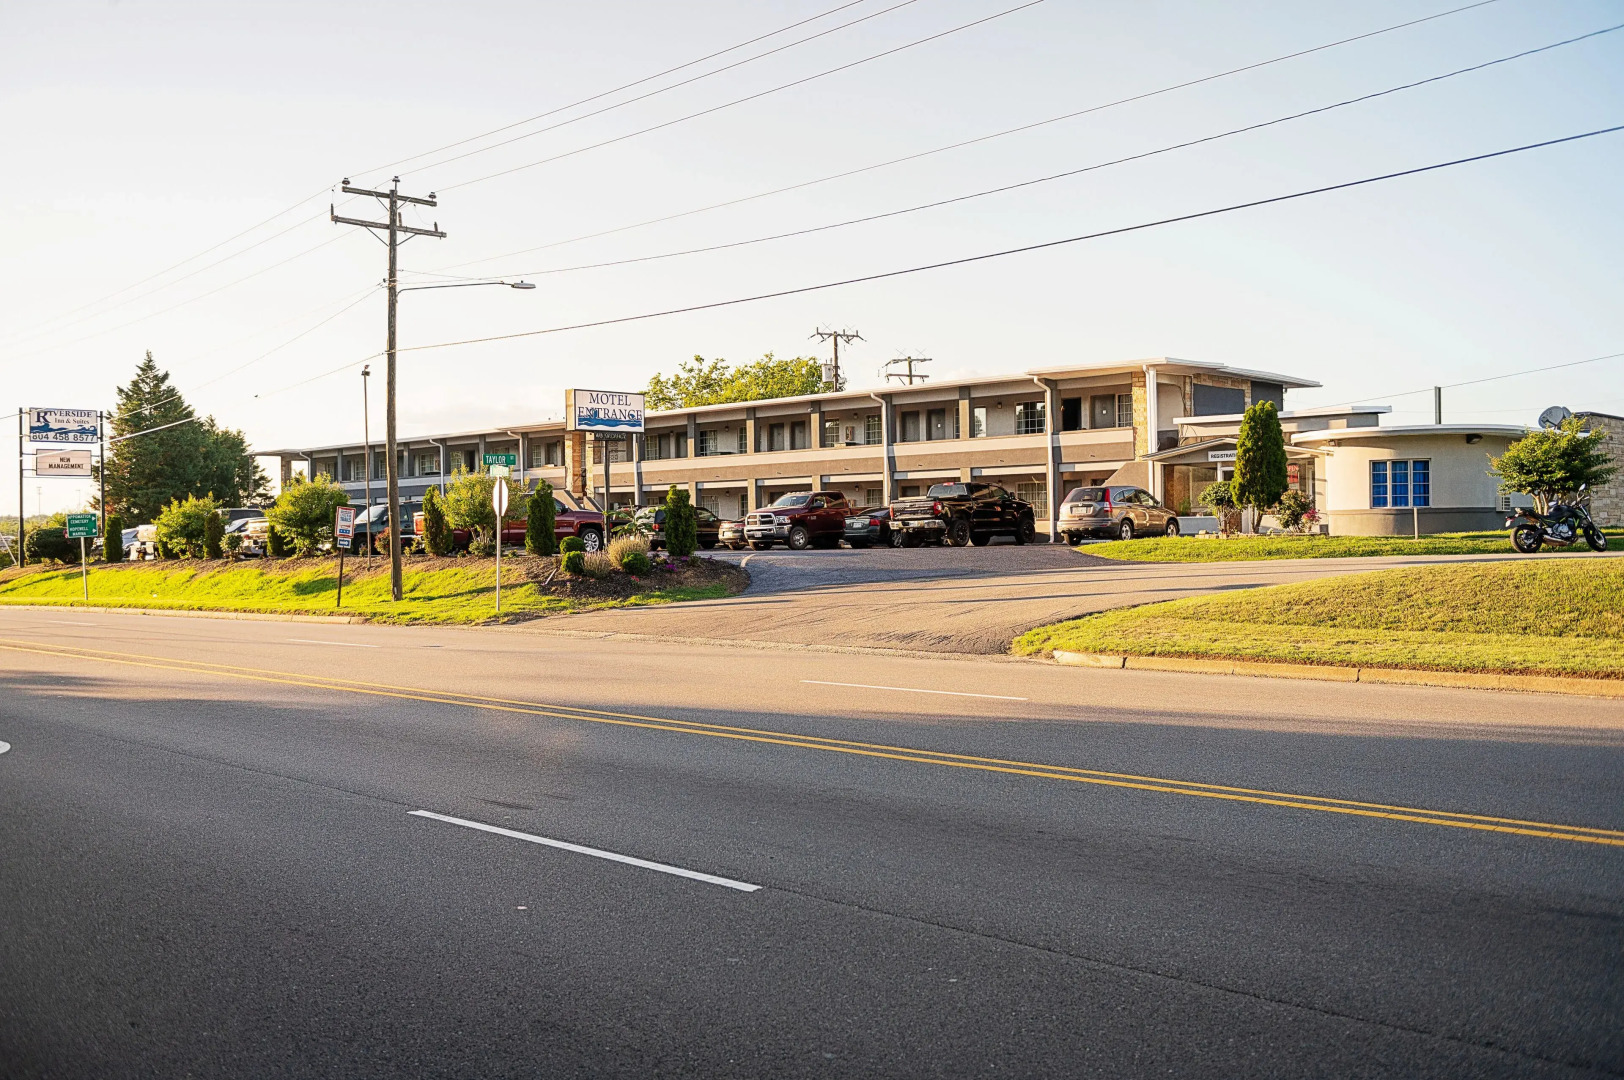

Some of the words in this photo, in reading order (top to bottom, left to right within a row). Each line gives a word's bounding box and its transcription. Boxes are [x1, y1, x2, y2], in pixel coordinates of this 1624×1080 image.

[589, 393, 631, 406] MOTEL
[35, 410, 92, 423] RIVERSIDE
[578, 406, 642, 420] ENTRANCE
[53, 433, 69, 441] 458
[486, 455, 506, 464] TAYLOR
